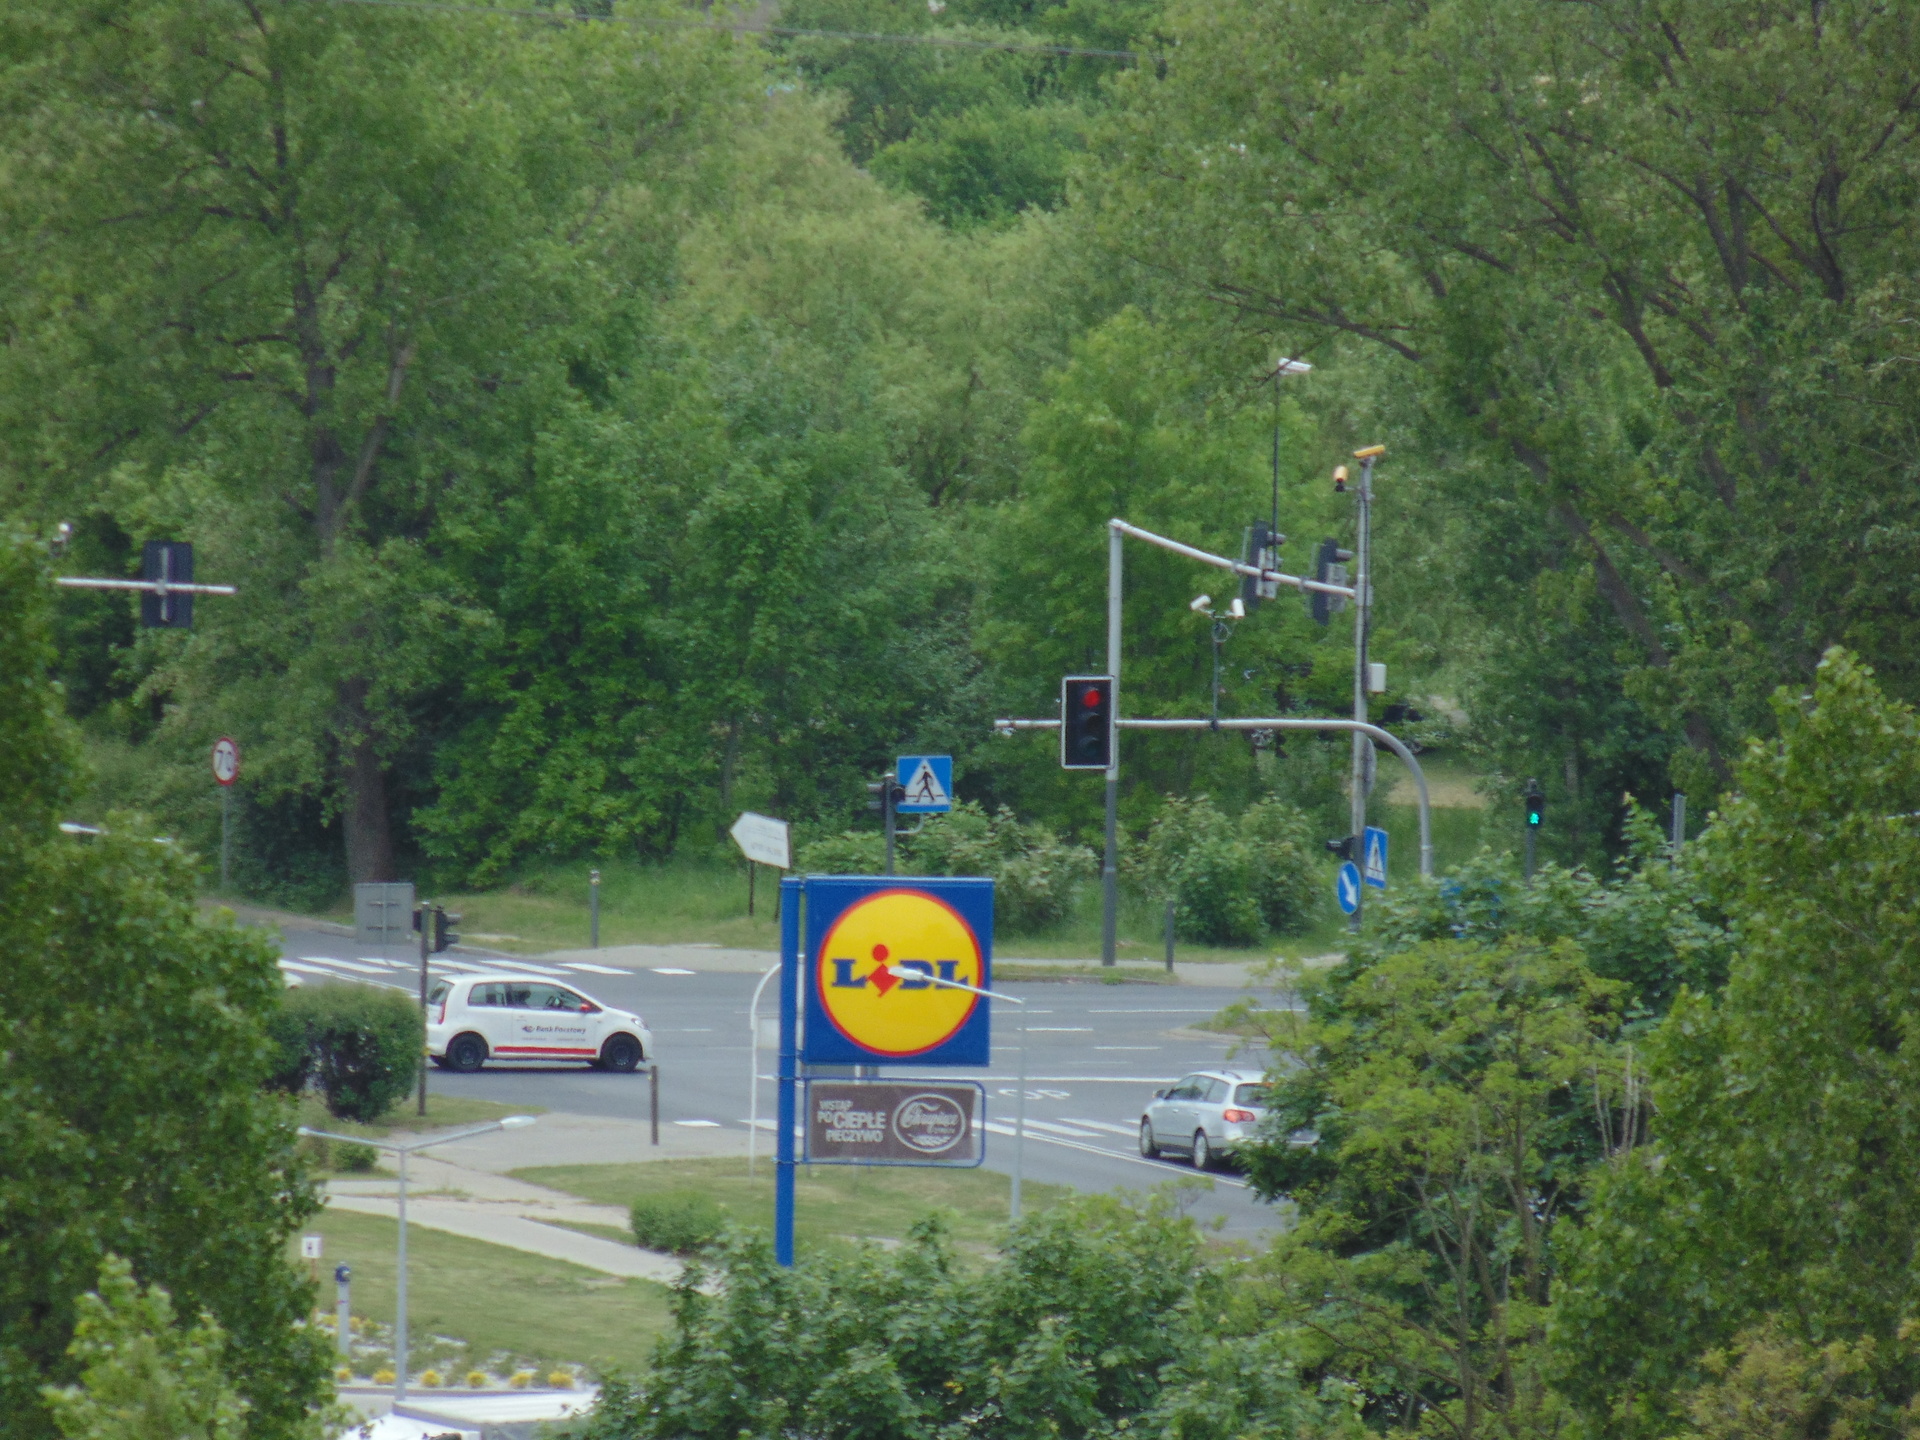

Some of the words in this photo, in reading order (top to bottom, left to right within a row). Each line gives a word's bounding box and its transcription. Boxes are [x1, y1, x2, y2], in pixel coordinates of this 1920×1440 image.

[217, 749, 232, 772] 70
[817, 1111, 833, 1123] PO
[826, 1129, 883, 1142] PIECZYWO
